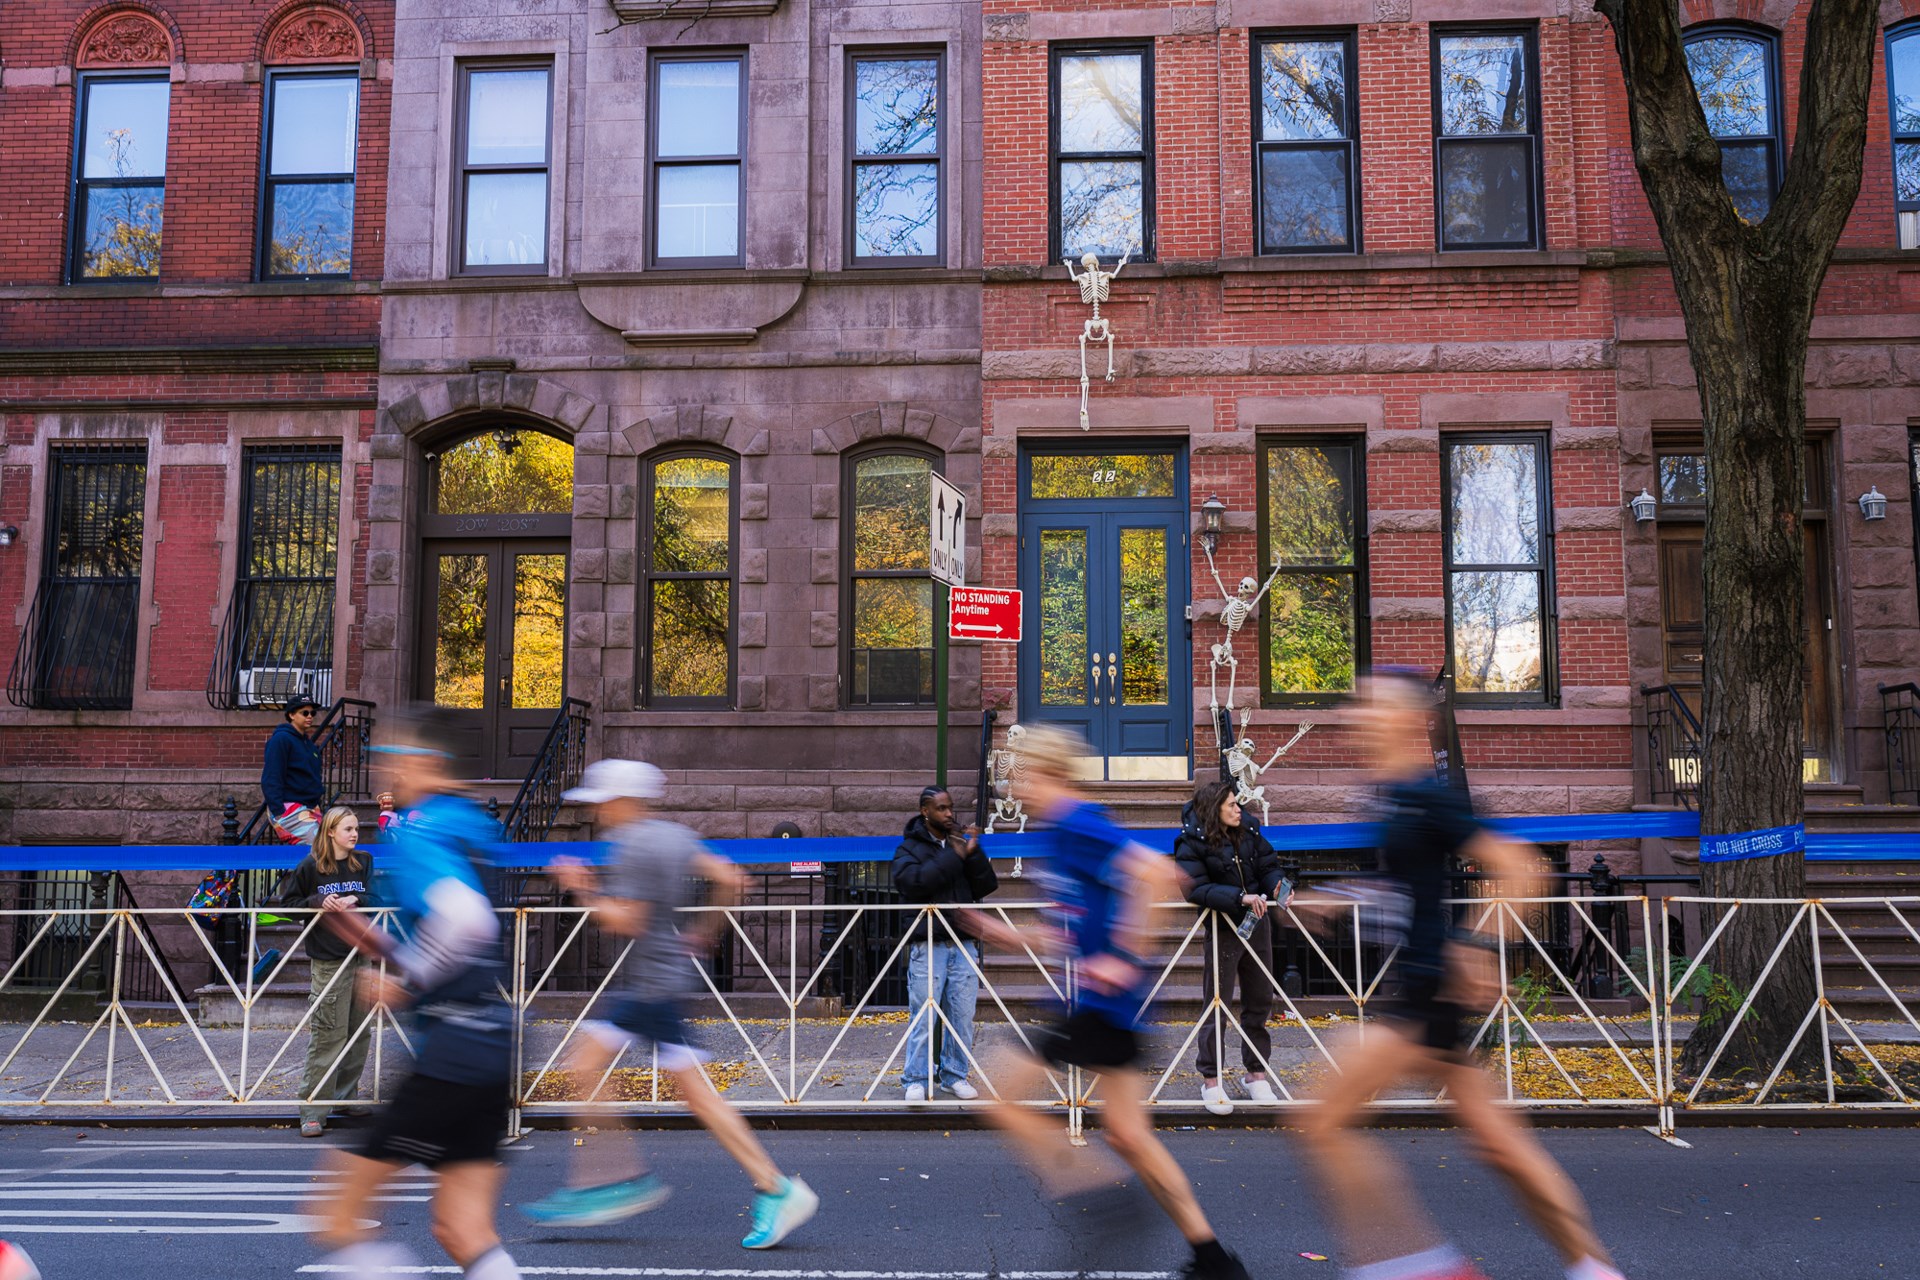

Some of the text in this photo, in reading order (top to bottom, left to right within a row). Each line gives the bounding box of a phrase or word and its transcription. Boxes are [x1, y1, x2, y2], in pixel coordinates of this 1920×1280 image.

[456, 518, 489, 532] 20W
[933, 547, 948, 571] ONLY
[951, 557, 964, 579] ONLY
[954, 591, 1010, 605] NO STANDING
[954, 603, 990, 616] Anytime
[1716, 841, 1729, 855] DO
[1730, 839, 1749, 853] NOT
[1751, 834, 1783, 850] CROSS
